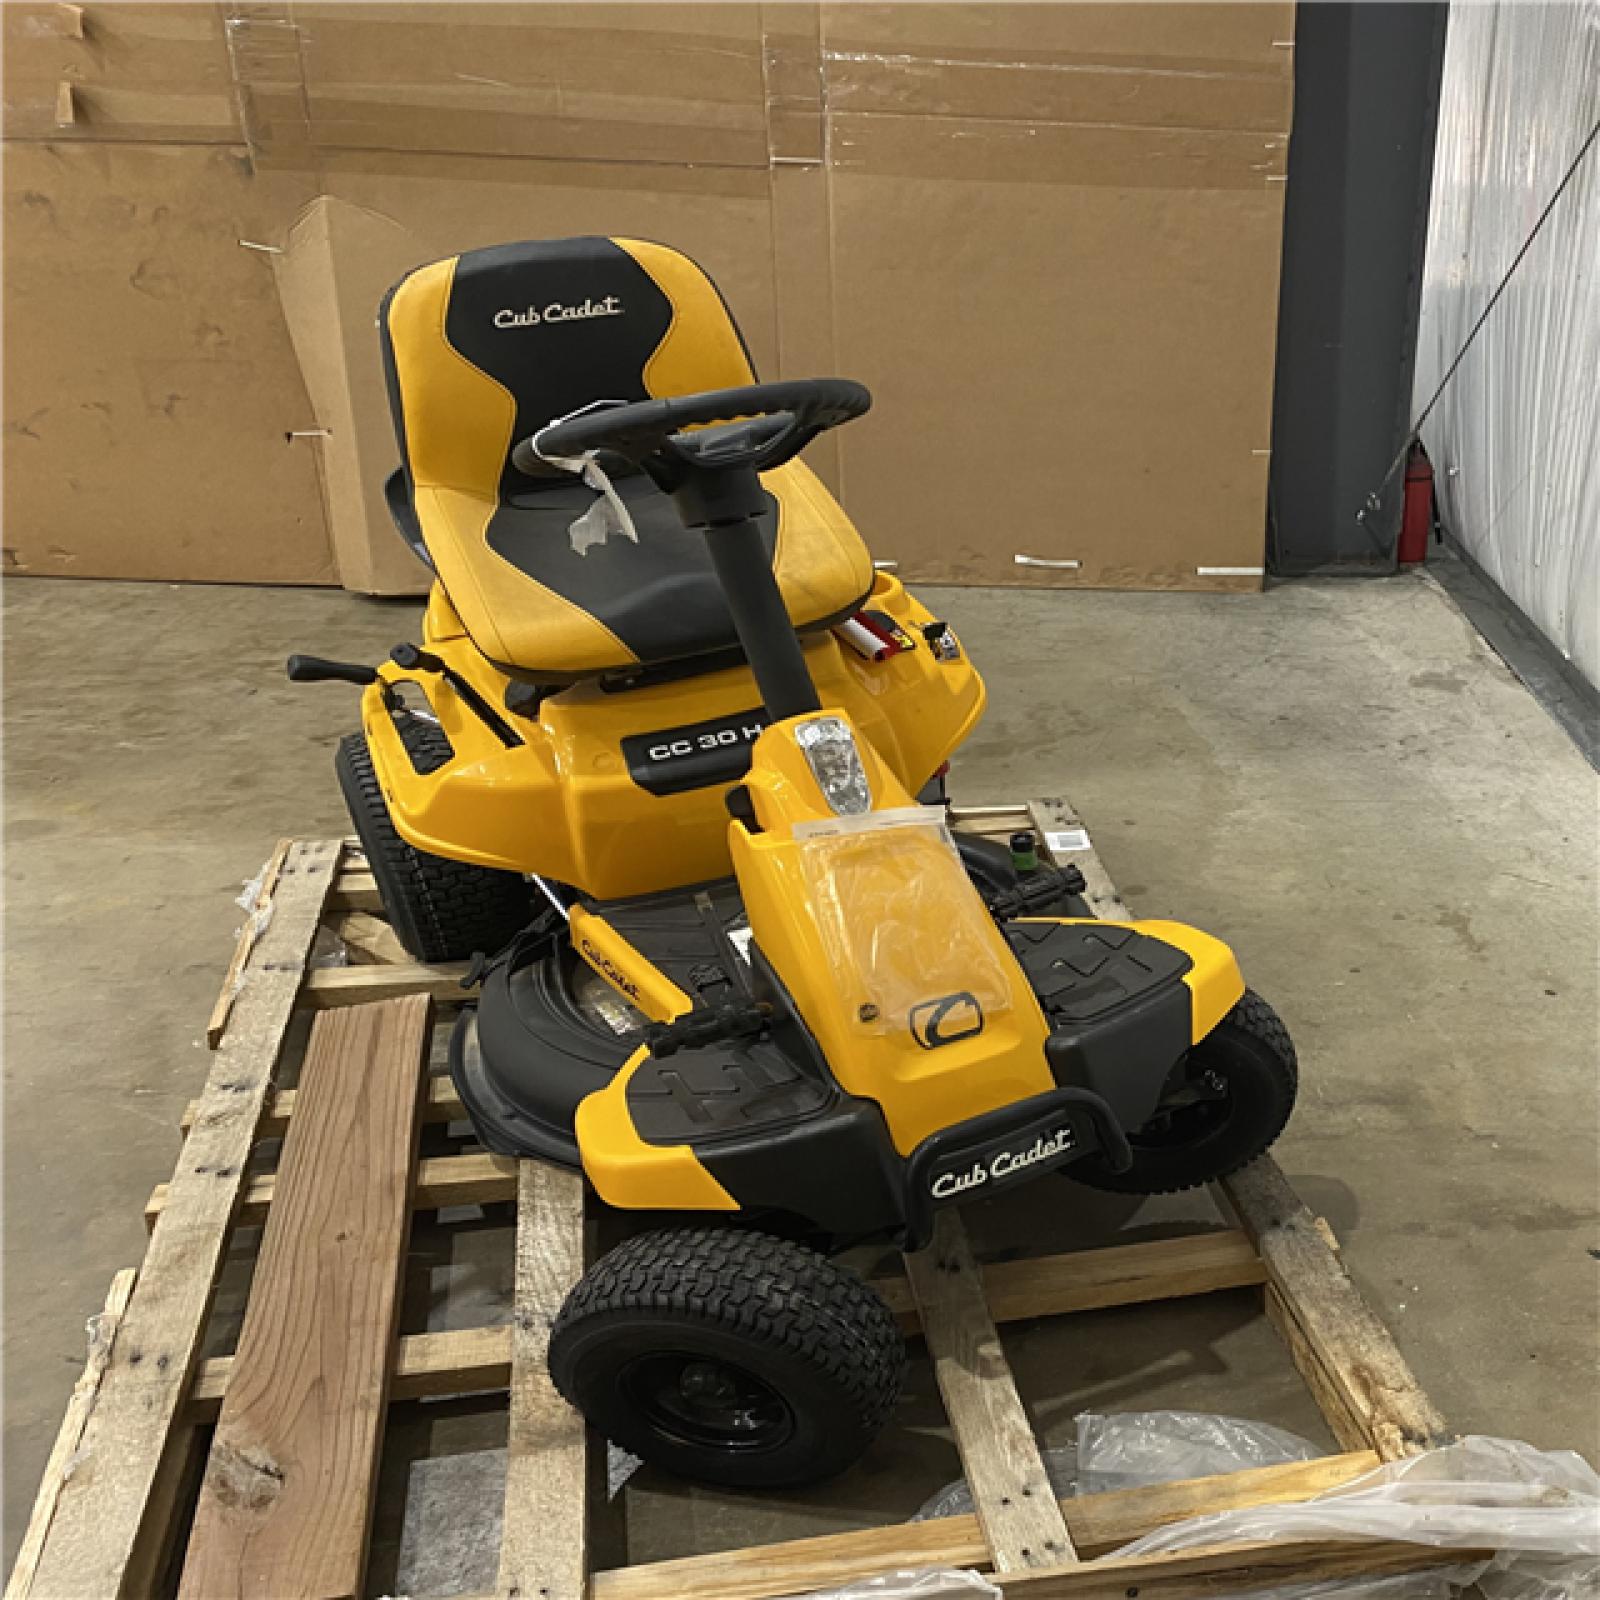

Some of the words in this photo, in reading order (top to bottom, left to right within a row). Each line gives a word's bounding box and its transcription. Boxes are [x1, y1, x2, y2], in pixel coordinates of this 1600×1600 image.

[494, 305, 541, 328] Cub
[543, 295, 624, 321] Cadet
[649, 740, 693, 760] CC
[698, 729, 738, 748] 30
[931, 1163, 988, 1198] Cub
[990, 1129, 1072, 1177] Cadet
